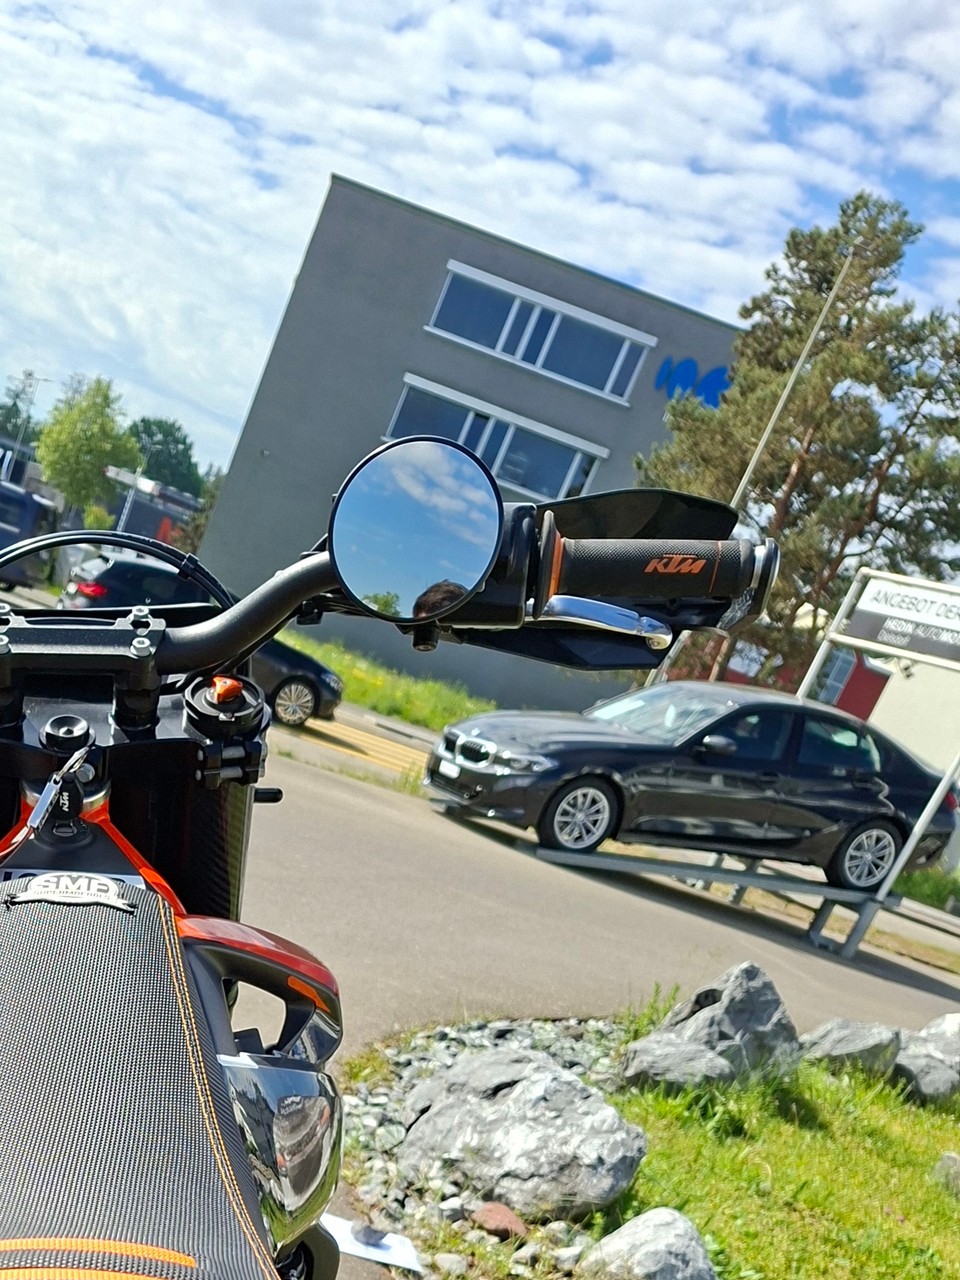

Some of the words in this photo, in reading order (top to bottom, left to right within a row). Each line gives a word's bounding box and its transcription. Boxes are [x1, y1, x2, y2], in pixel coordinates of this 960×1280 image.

[644, 554, 707, 574] KTM
[914, 622, 960, 646] AUTOMO
[59, 791, 70, 812] KTM
